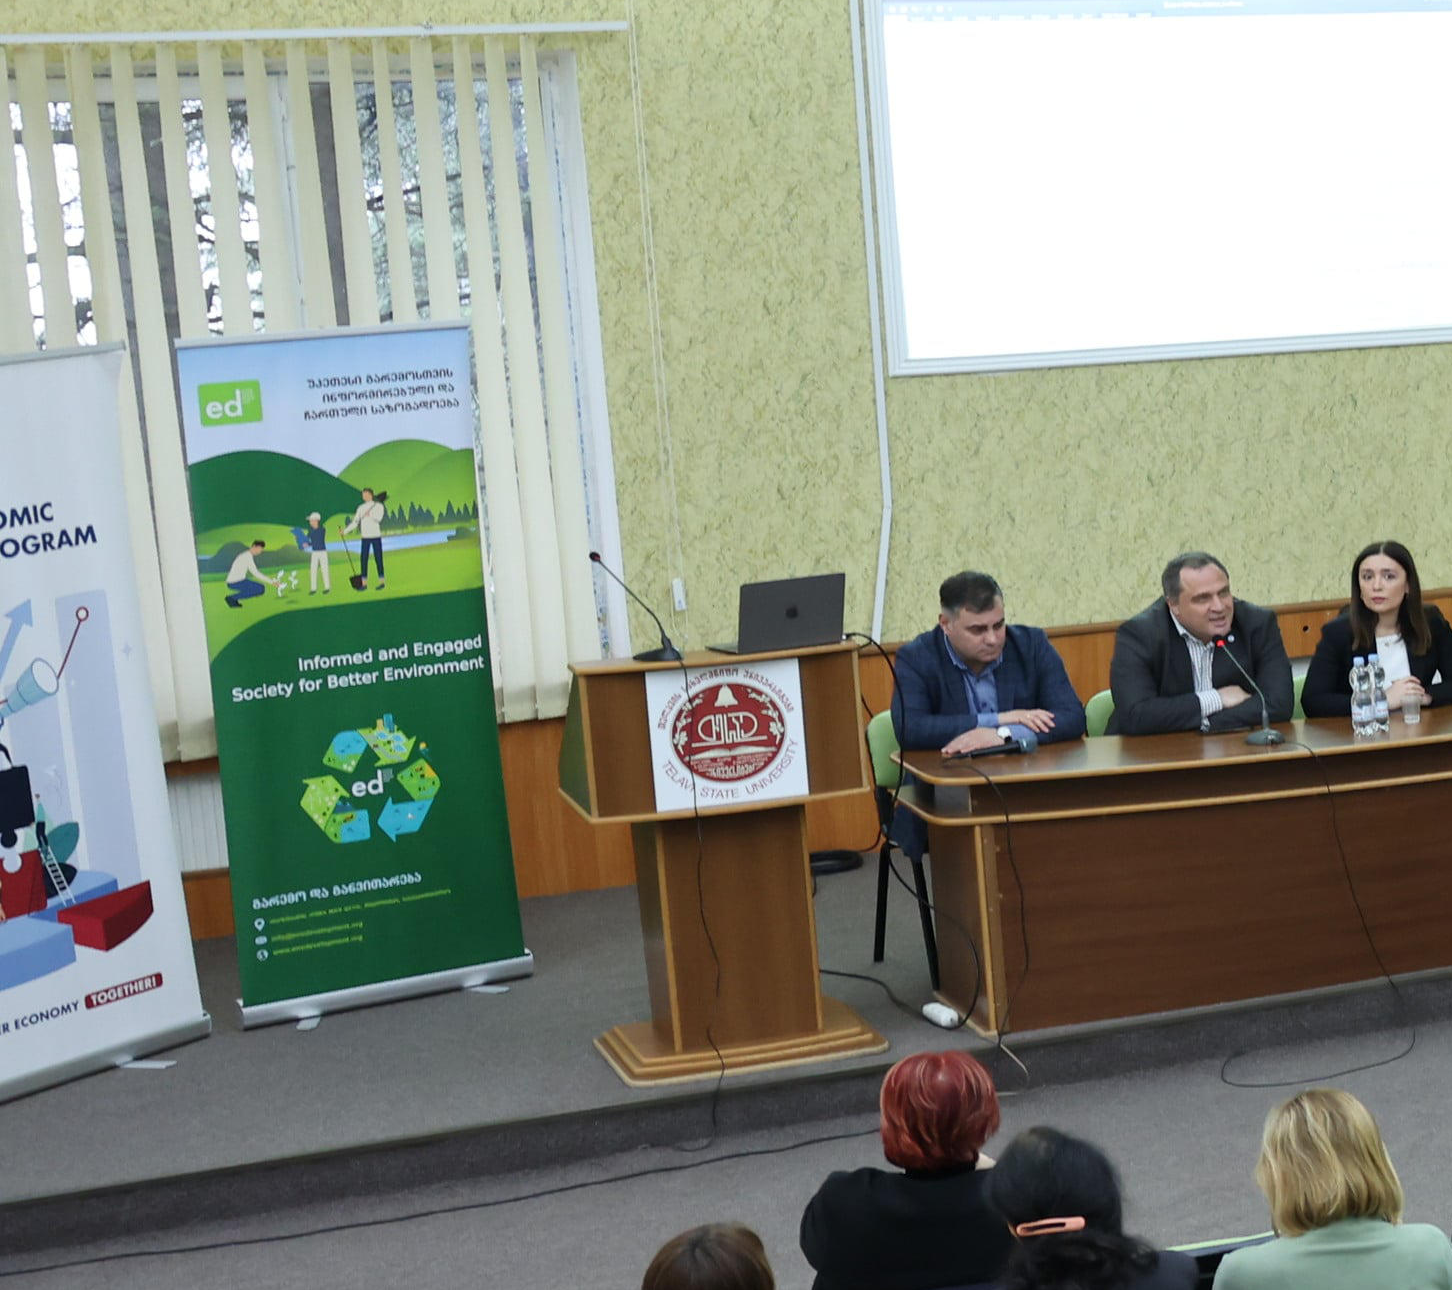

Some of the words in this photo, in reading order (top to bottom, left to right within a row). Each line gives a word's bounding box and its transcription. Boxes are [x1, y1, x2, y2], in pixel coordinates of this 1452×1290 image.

[205, 389, 243, 419] ed
[298, 649, 374, 671] Informed
[378, 644, 409, 662] and
[413, 634, 482, 657] Engaged
[232, 681, 293, 702] Society
[298, 677, 323, 693] for
[327, 670, 379, 689] Better
[383, 656, 484, 681] Environment
[351, 769, 383, 797] ed
[700, 787, 739, 799] STATE
[14, 1001, 79, 1030] ECONOMY
[91, 975, 157, 1006] TOGETHER!
